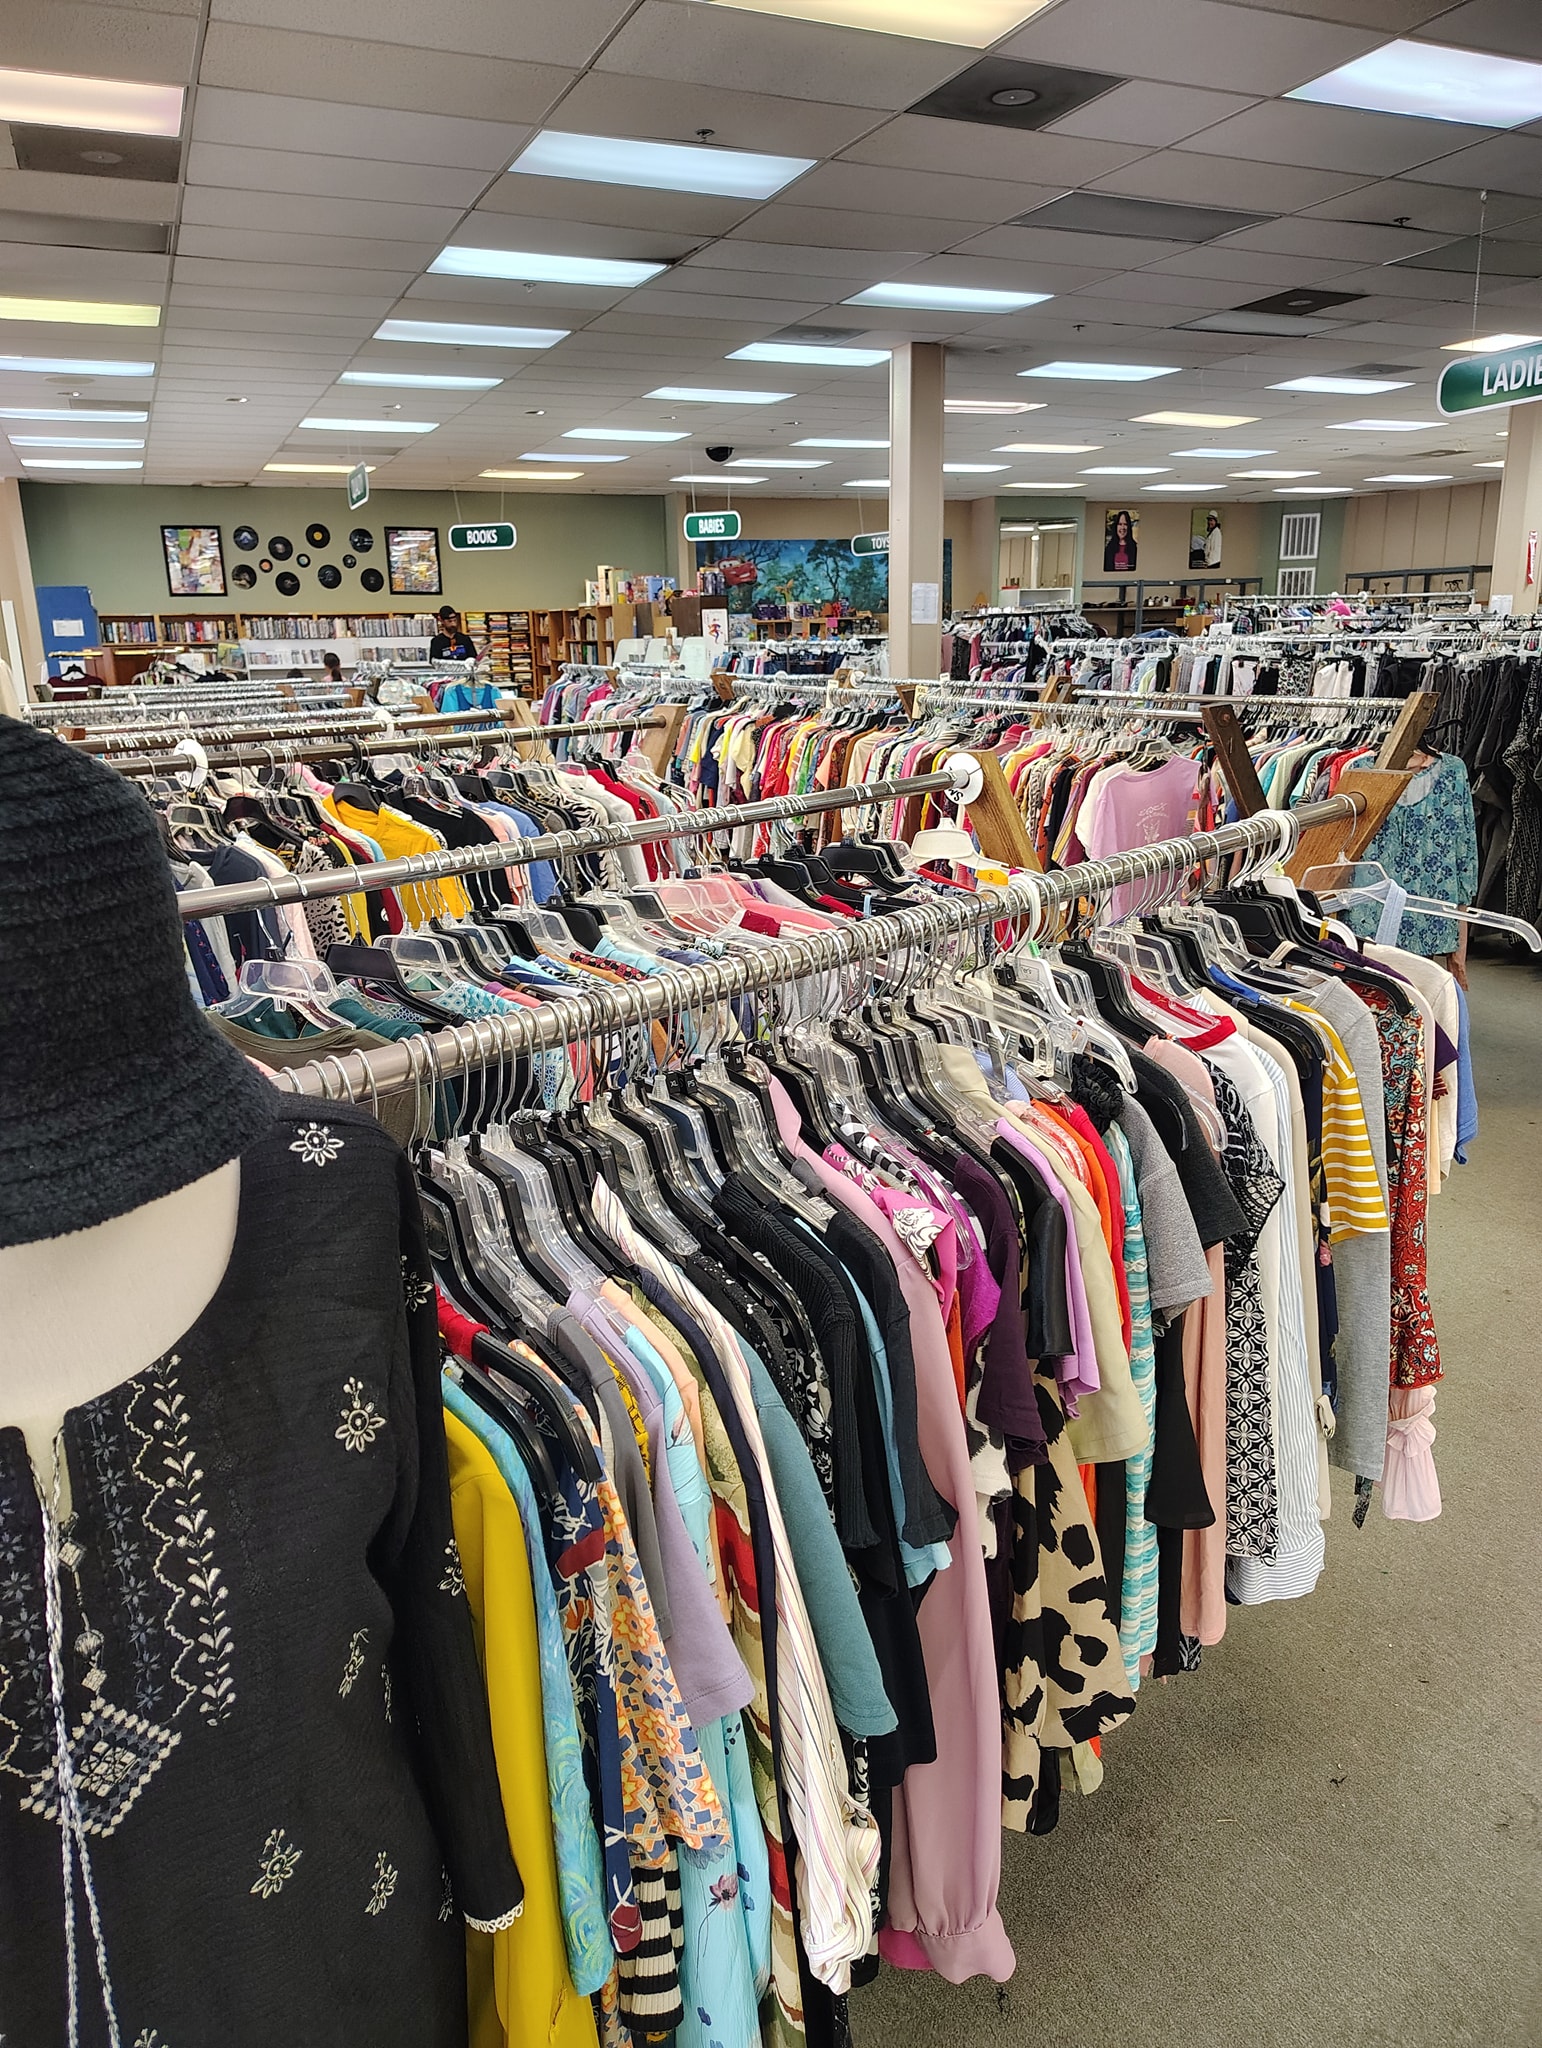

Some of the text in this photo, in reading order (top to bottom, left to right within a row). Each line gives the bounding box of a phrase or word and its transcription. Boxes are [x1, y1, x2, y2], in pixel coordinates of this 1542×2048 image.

[1482, 354, 1542, 396] LADIE
[699, 518, 725, 534] BABIES
[466, 529, 498, 544] BOOKS
[988, 872, 994, 881] S
[755, 1048, 762, 1057] XL
[723, 1054, 729, 1063] M
[670, 1080, 679, 1088] XL
[687, 1079, 696, 1088] PS
[525, 1132, 536, 1141] XL
